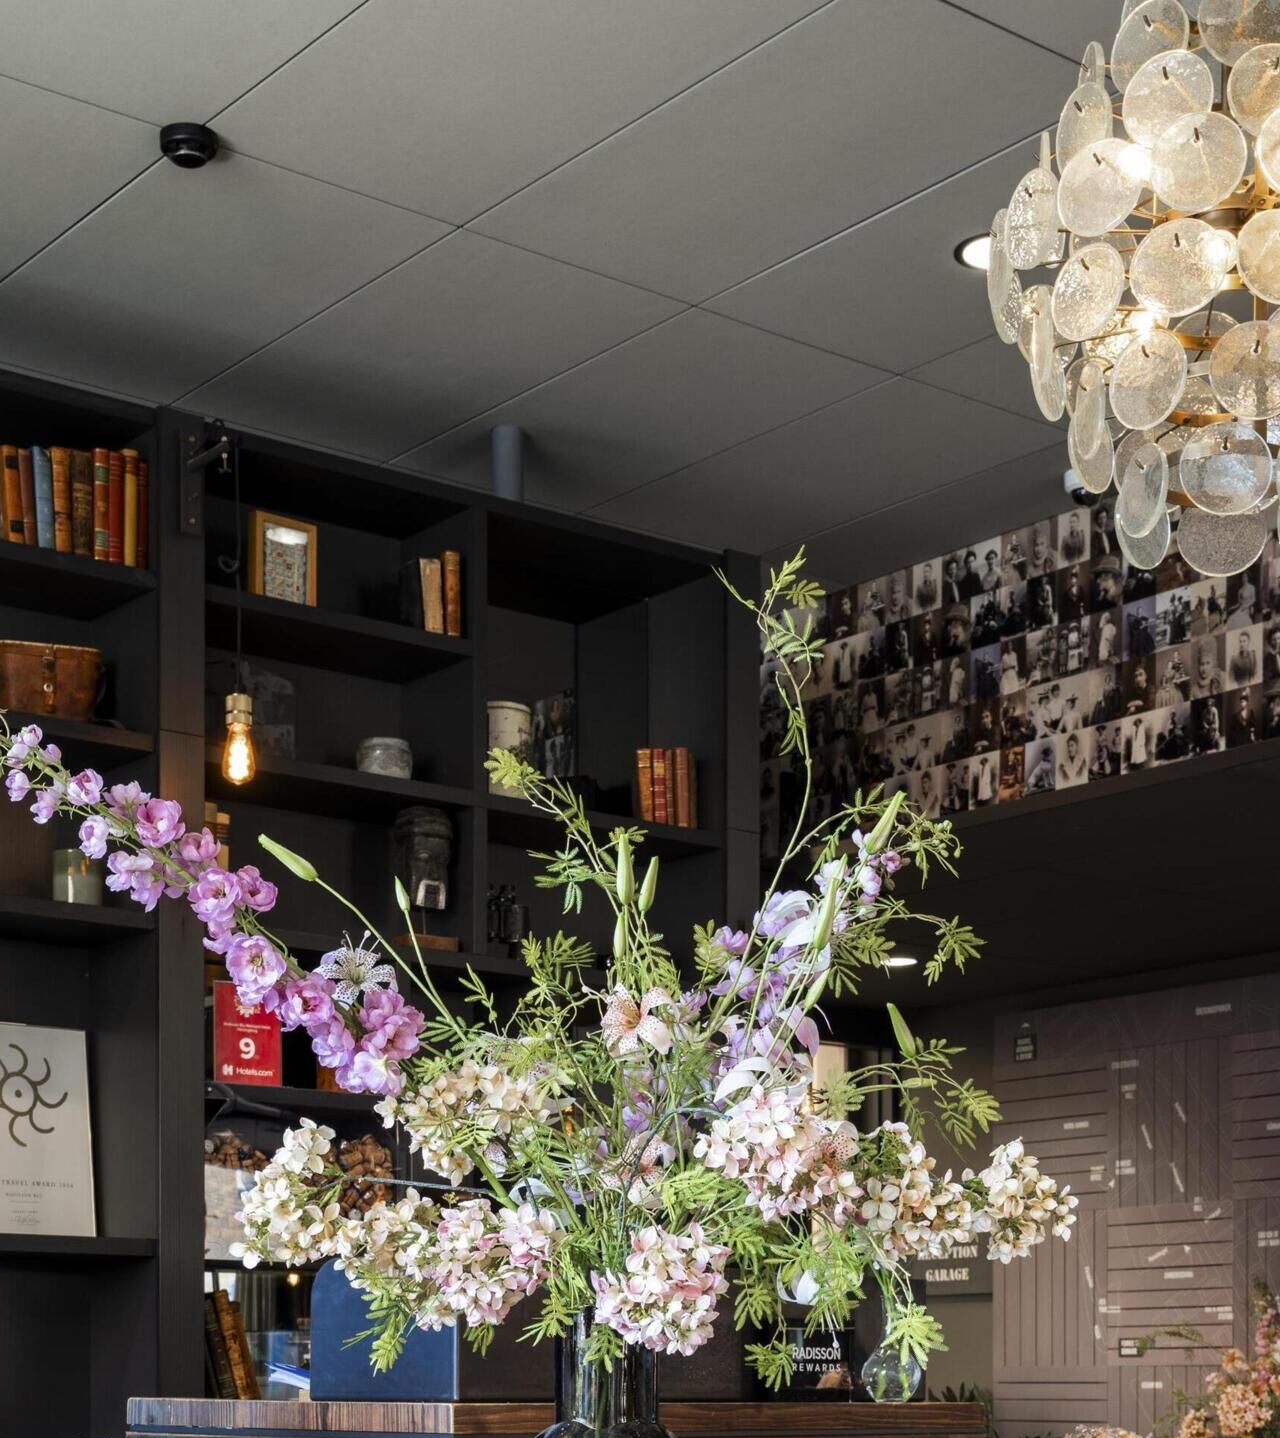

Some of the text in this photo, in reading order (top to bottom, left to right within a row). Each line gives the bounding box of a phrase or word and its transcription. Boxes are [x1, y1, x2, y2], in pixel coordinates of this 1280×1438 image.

[239, 1037, 256, 1060] 9
[236, 1067, 273, 1077] Hotels.com
[925, 1267, 969, 1282] GARAGE
[792, 1346, 841, 1360] RADISSON
[792, 1363, 841, 1372] REWARDS
